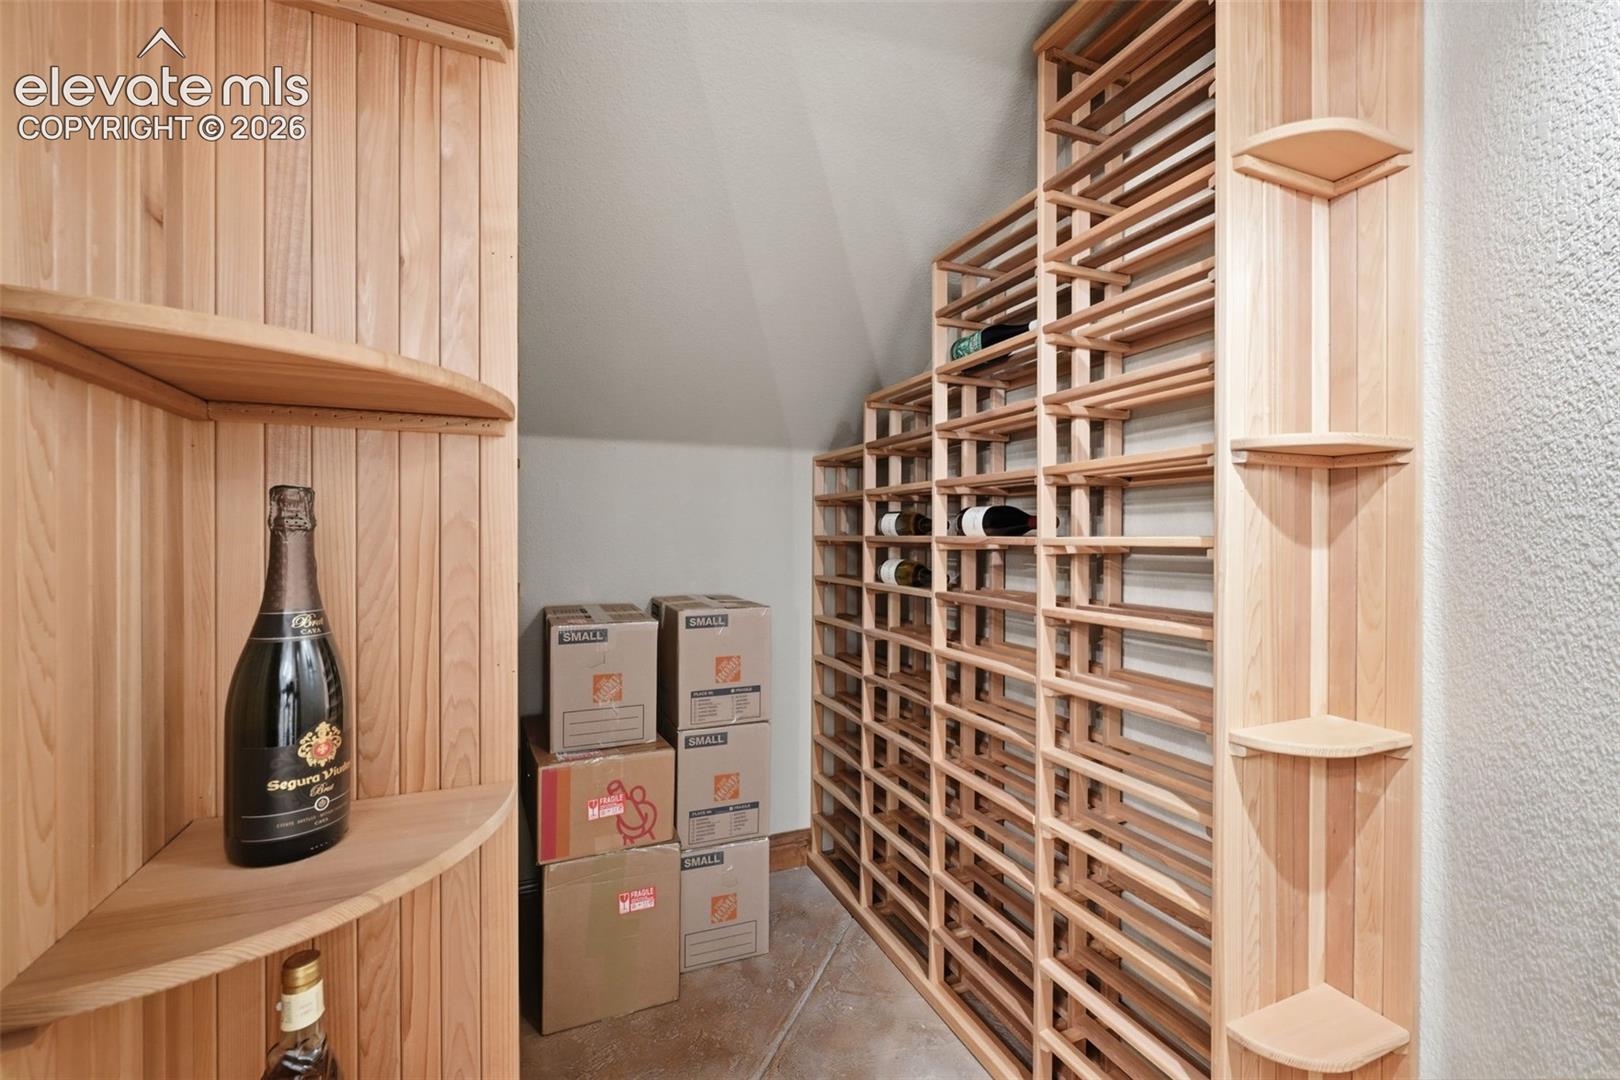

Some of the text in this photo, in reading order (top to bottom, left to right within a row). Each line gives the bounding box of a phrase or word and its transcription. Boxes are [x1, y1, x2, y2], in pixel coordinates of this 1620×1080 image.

[688, 616, 725, 627] SMALL
[562, 631, 604, 642] SMALL
[688, 735, 725, 747] SMALL
[267, 774, 321, 791] Segura
[600, 794, 625, 806] FRAGILE
[684, 855, 721, 869] SMALL
[631, 888, 654, 900] FRAGILE
